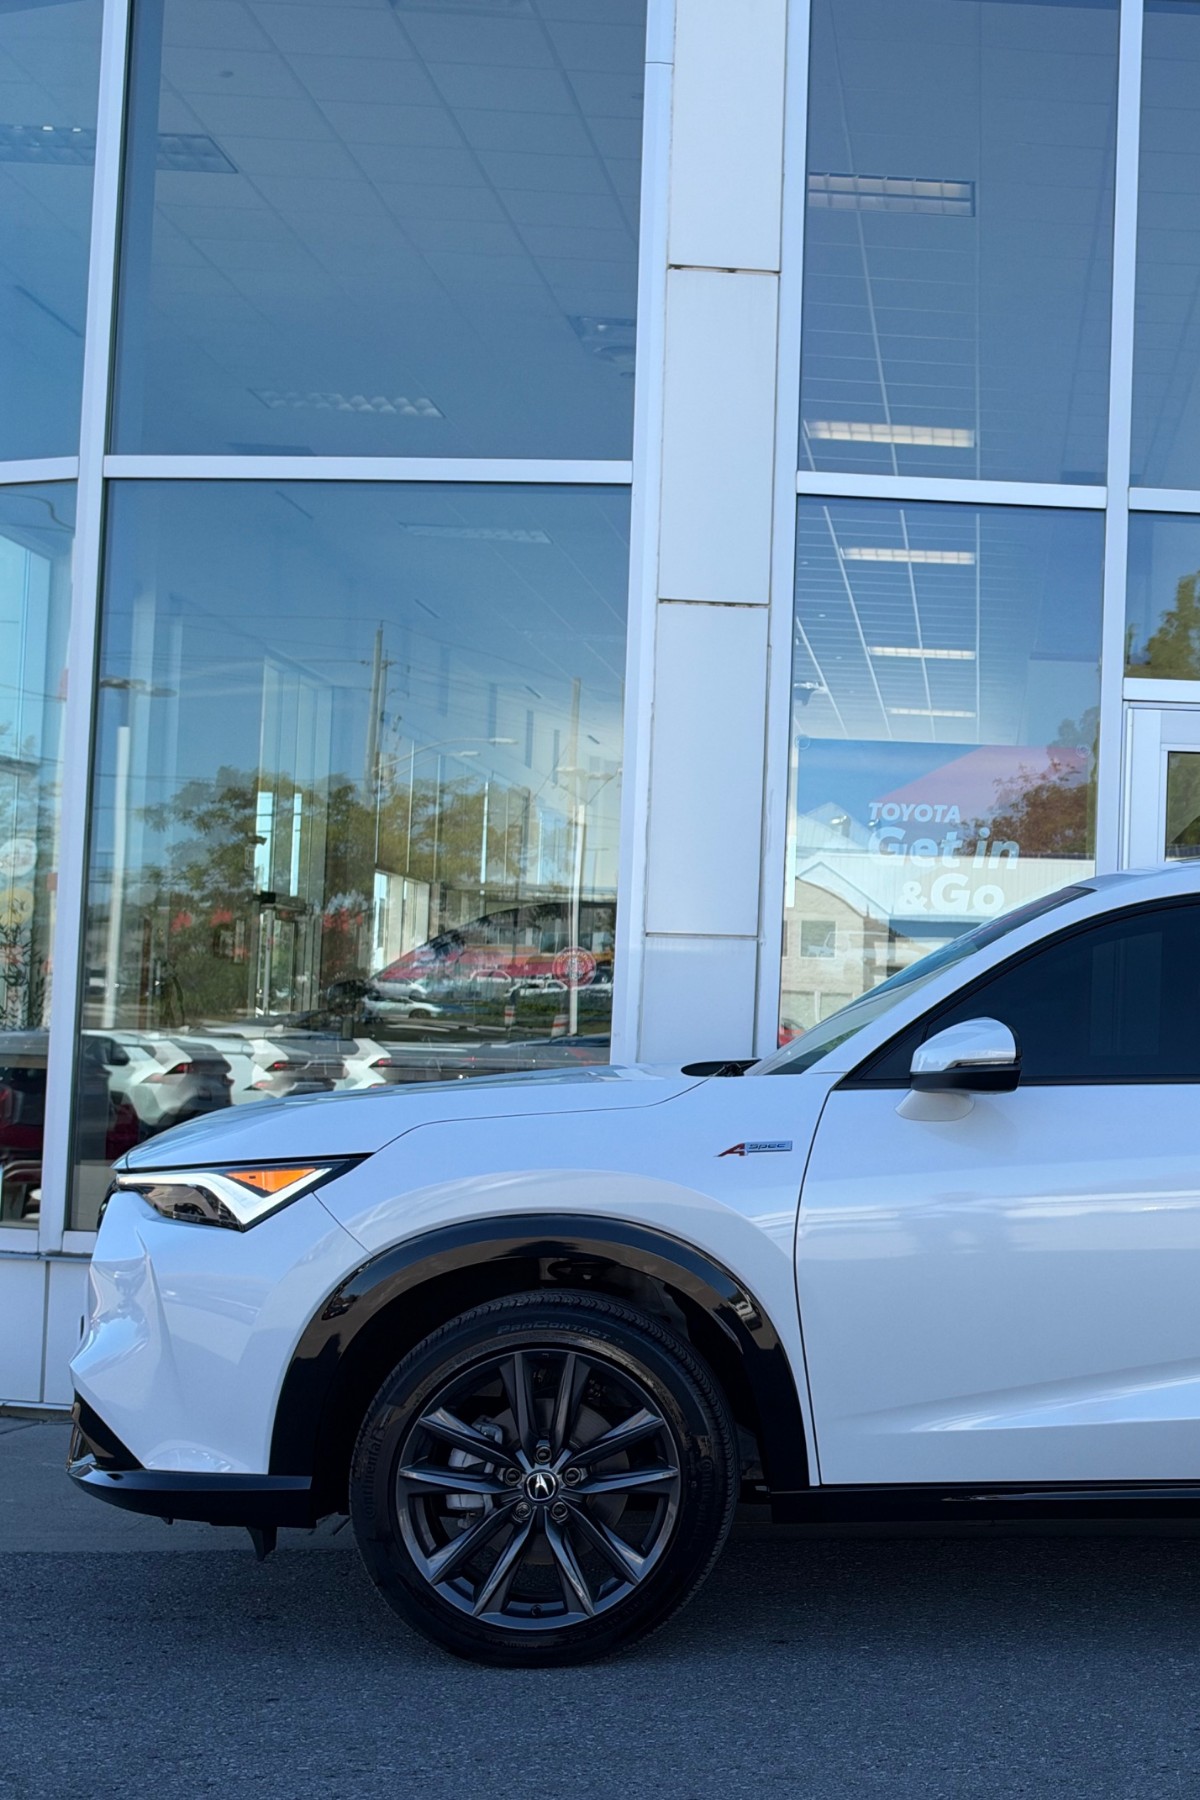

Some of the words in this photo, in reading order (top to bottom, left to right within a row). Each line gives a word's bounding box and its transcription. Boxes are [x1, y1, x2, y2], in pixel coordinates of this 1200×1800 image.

[868, 802, 961, 823] TOYOTA
[868, 827, 963, 868] Get
[972, 827, 1020, 870] in
